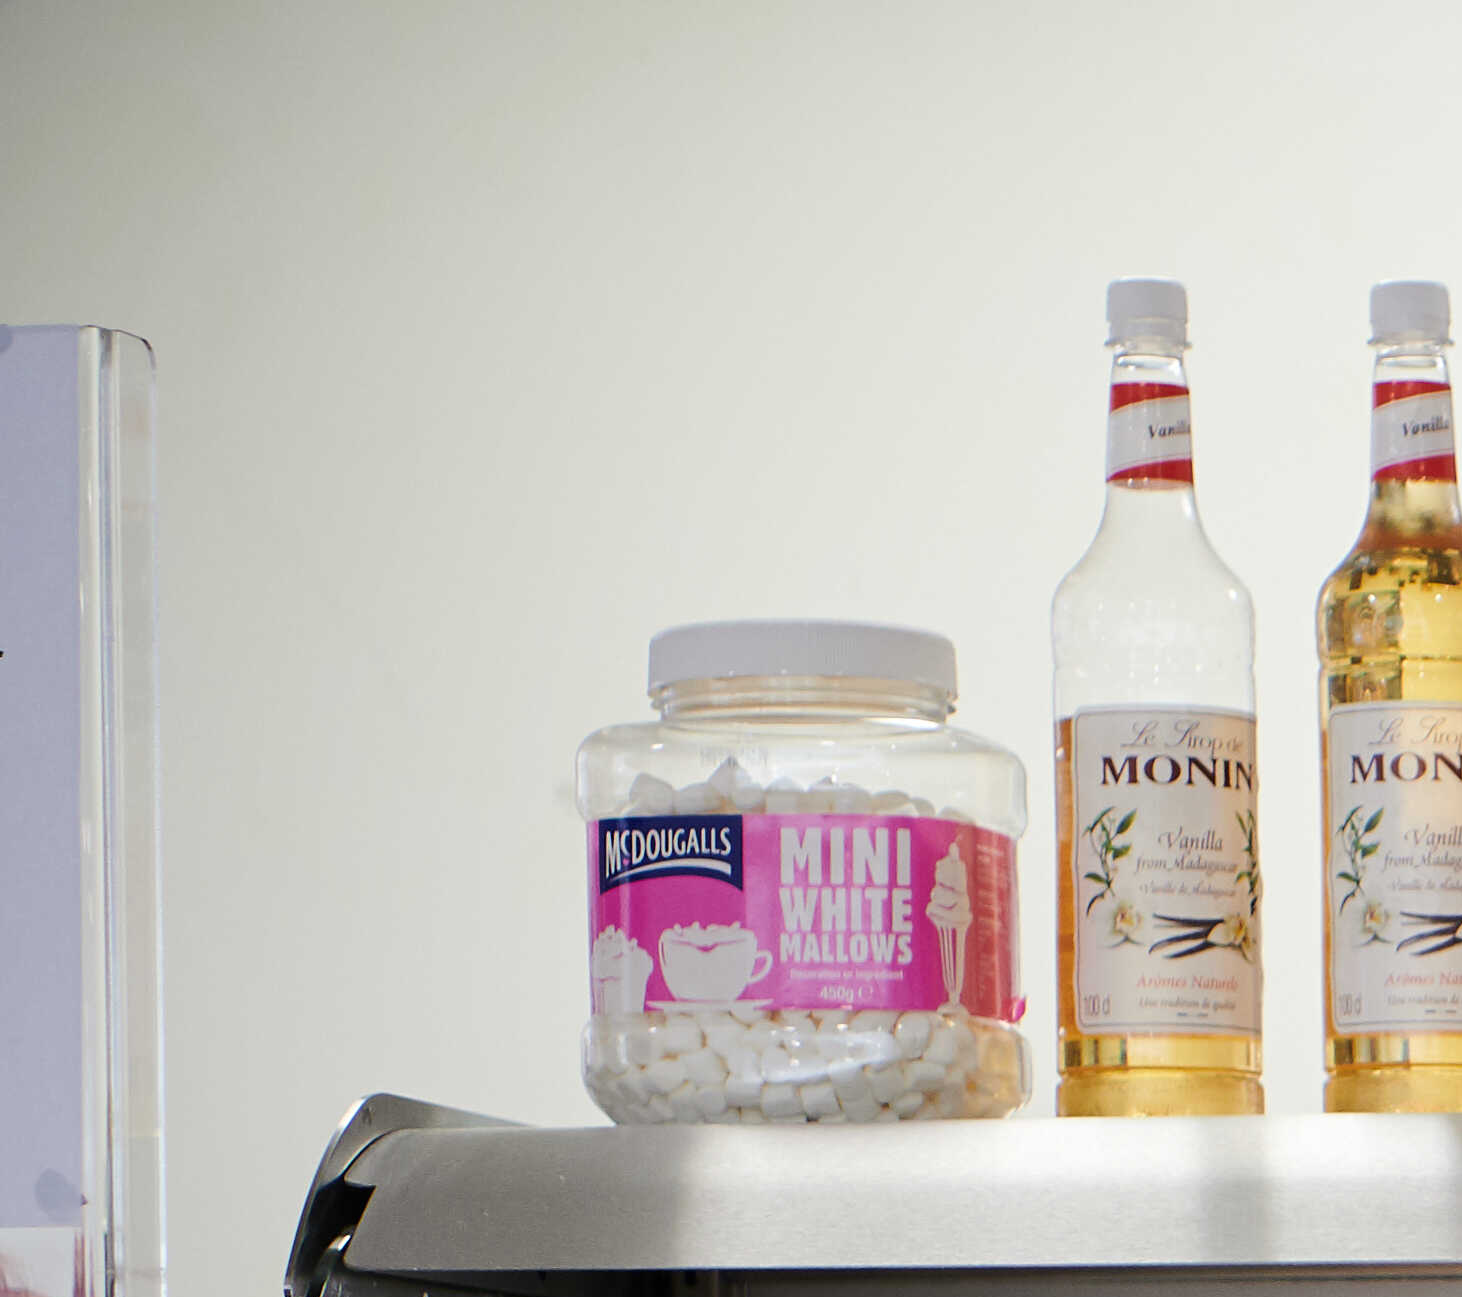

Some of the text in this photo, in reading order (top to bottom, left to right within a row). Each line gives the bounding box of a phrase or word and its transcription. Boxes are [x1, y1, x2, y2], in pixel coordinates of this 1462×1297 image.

[1101, 755, 1253, 790] MONIN
[780, 827, 911, 885] MINI
[1157, 827, 1224, 852] Vanilla
[779, 887, 912, 933] WHITE
[780, 934, 912, 965] MALLOWS
